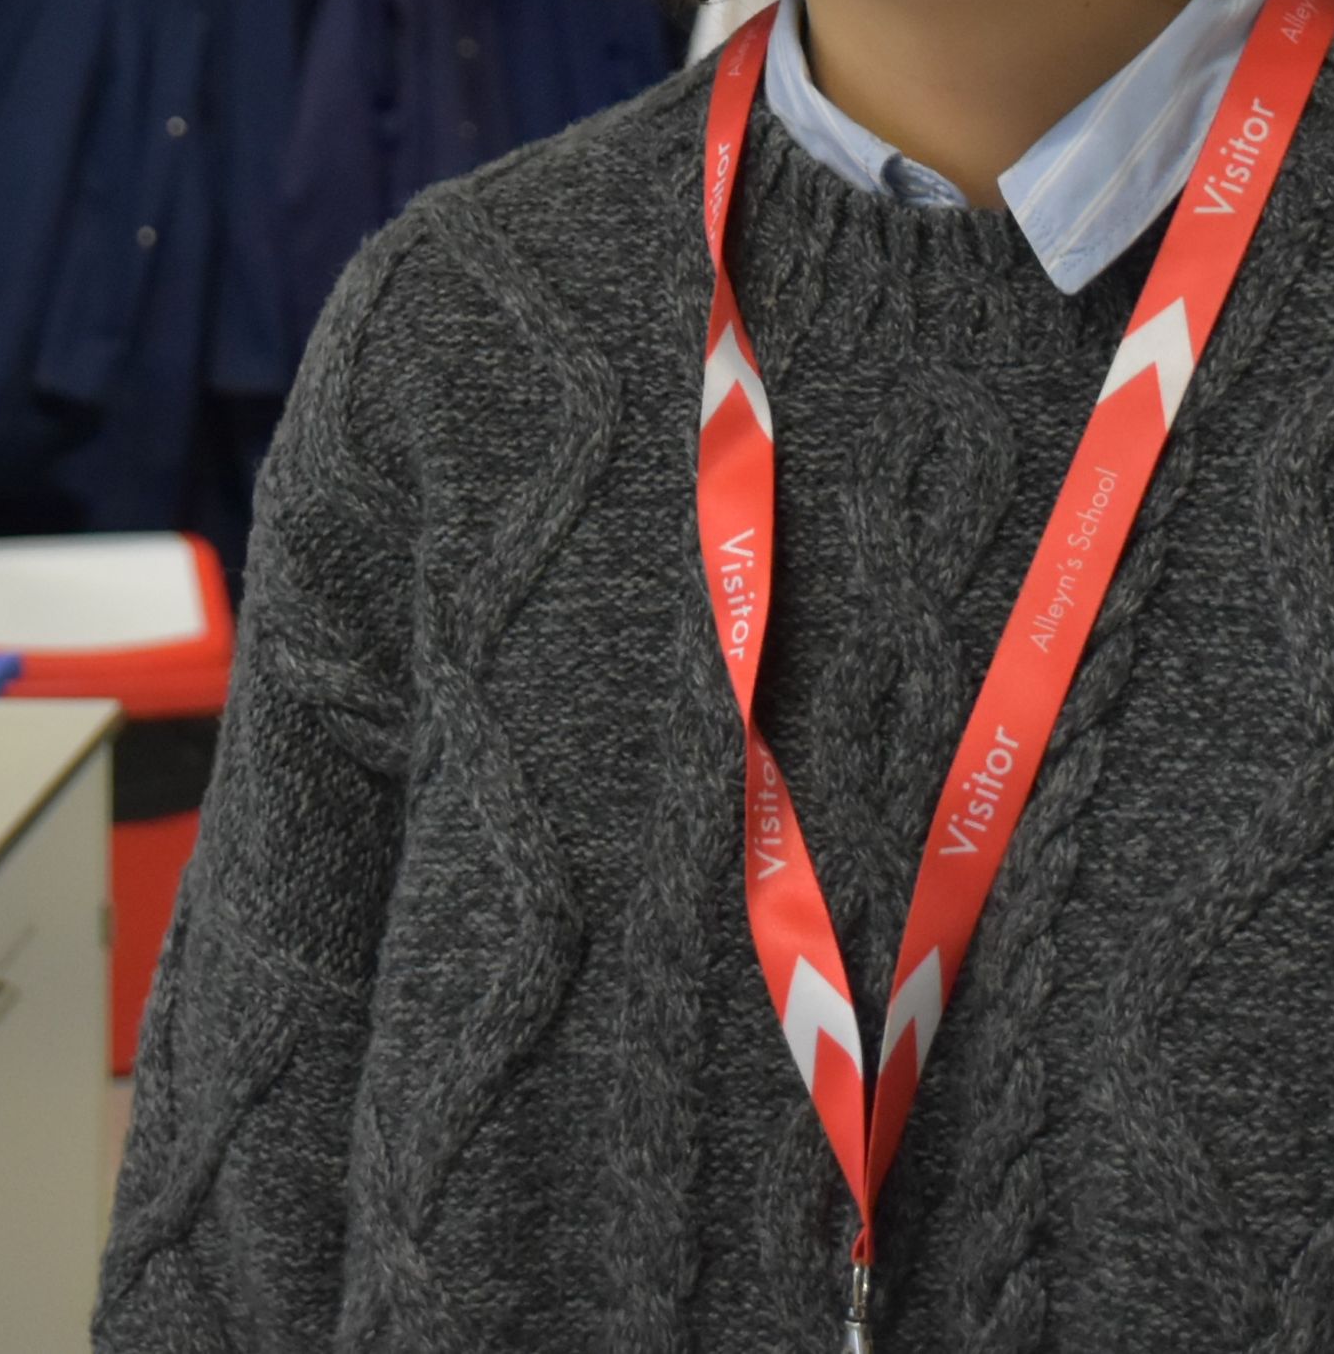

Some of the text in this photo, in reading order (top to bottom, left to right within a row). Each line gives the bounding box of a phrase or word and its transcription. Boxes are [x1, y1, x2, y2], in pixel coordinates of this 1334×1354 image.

[1193, 97, 1276, 217] Visitor
[719, 527, 756, 662] Visitor
[1029, 466, 1120, 654] Alleyn's School
[938, 725, 1020, 858] Visitor
